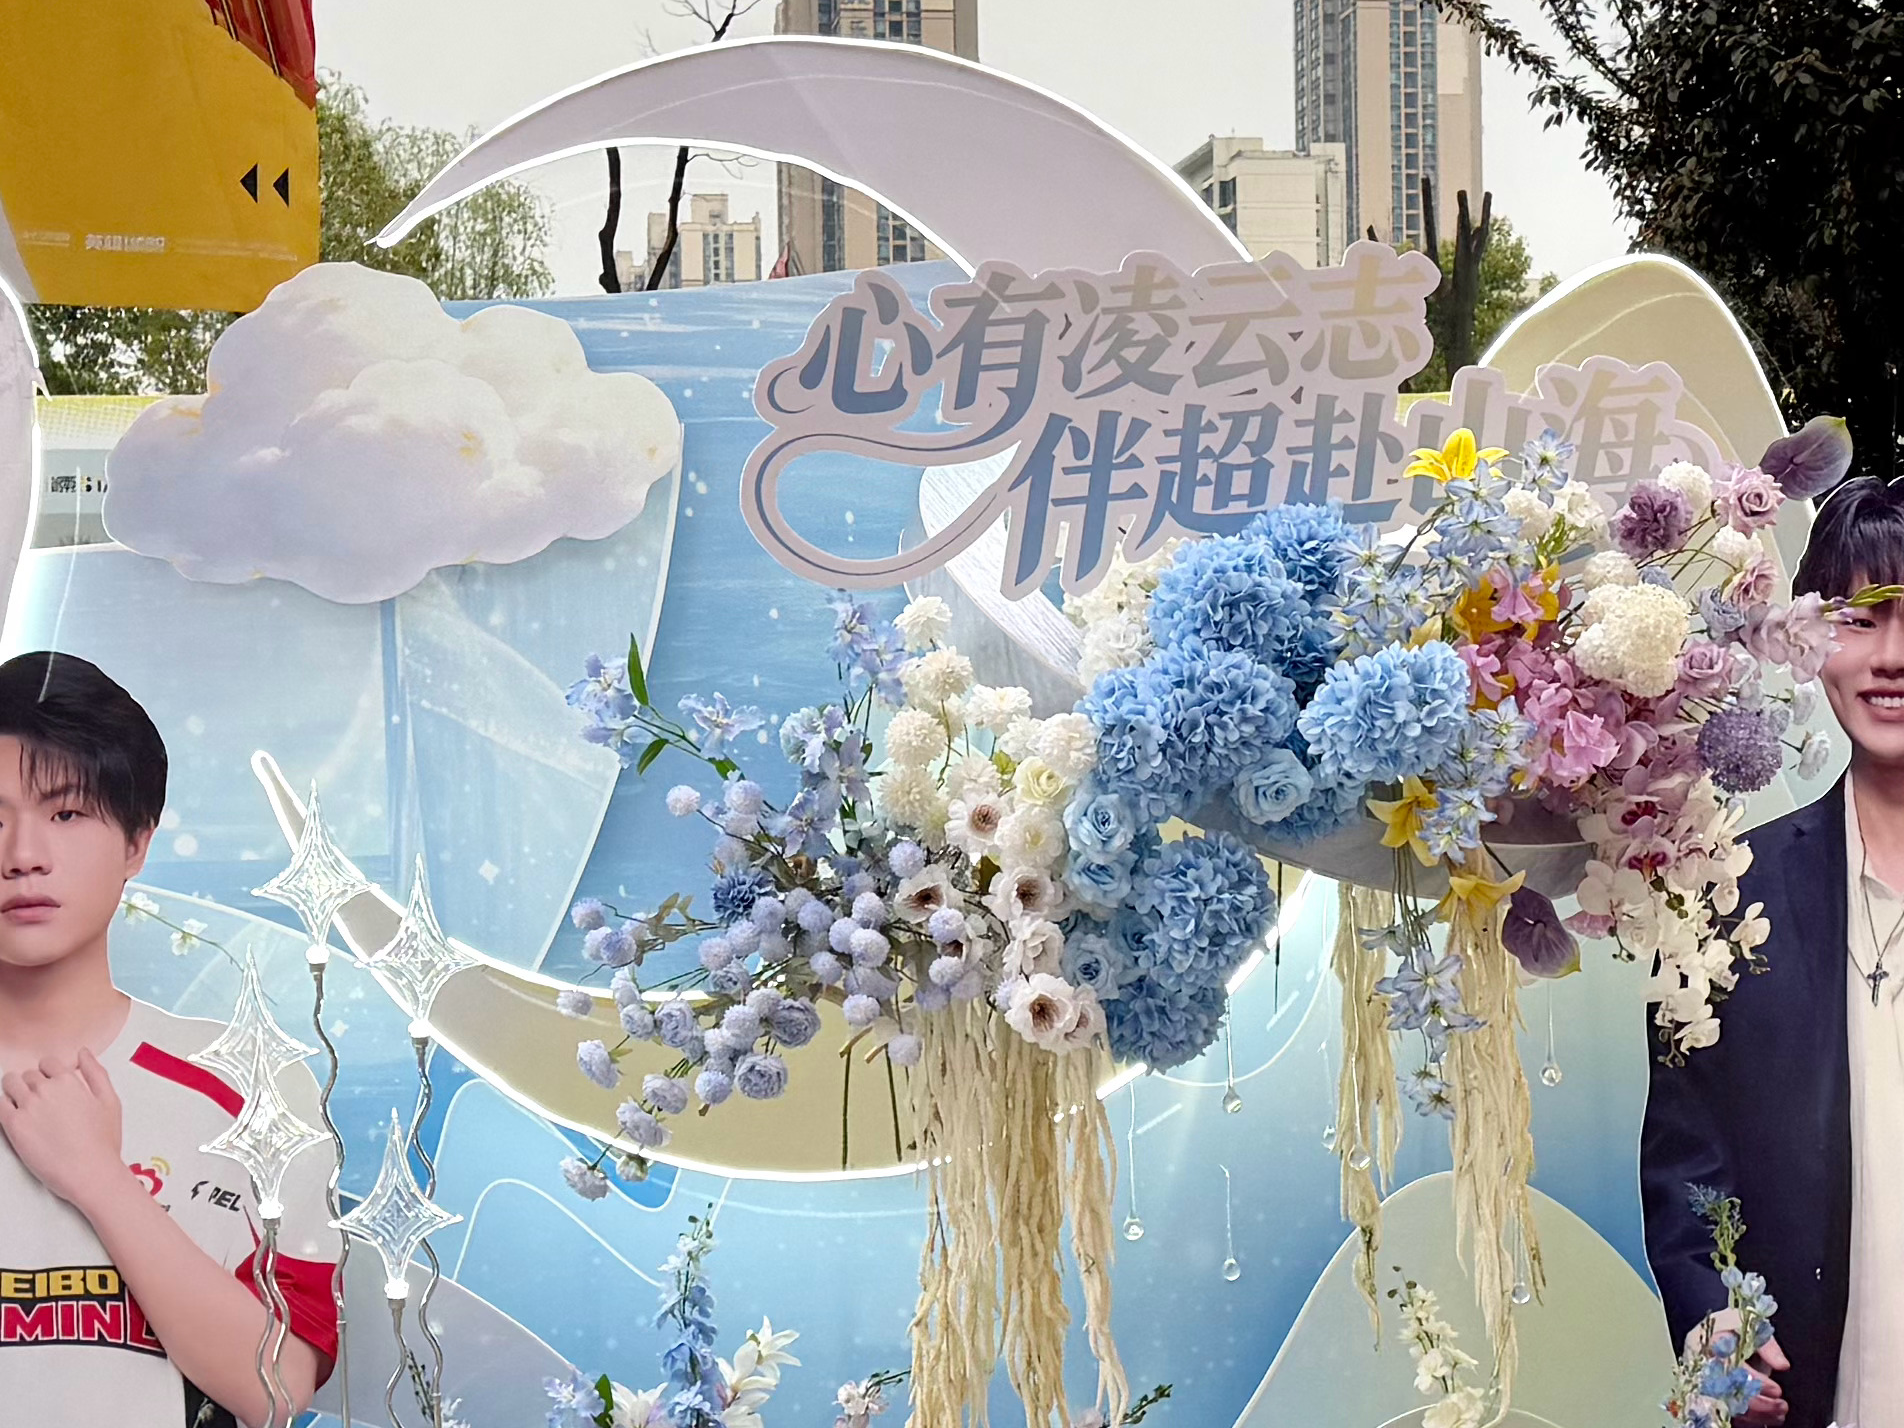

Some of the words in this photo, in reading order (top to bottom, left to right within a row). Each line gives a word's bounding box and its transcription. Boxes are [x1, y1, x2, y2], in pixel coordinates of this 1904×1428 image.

[786, 248, 1430, 438] 心有凌云志
[208, 1186, 241, 1212] PEL
